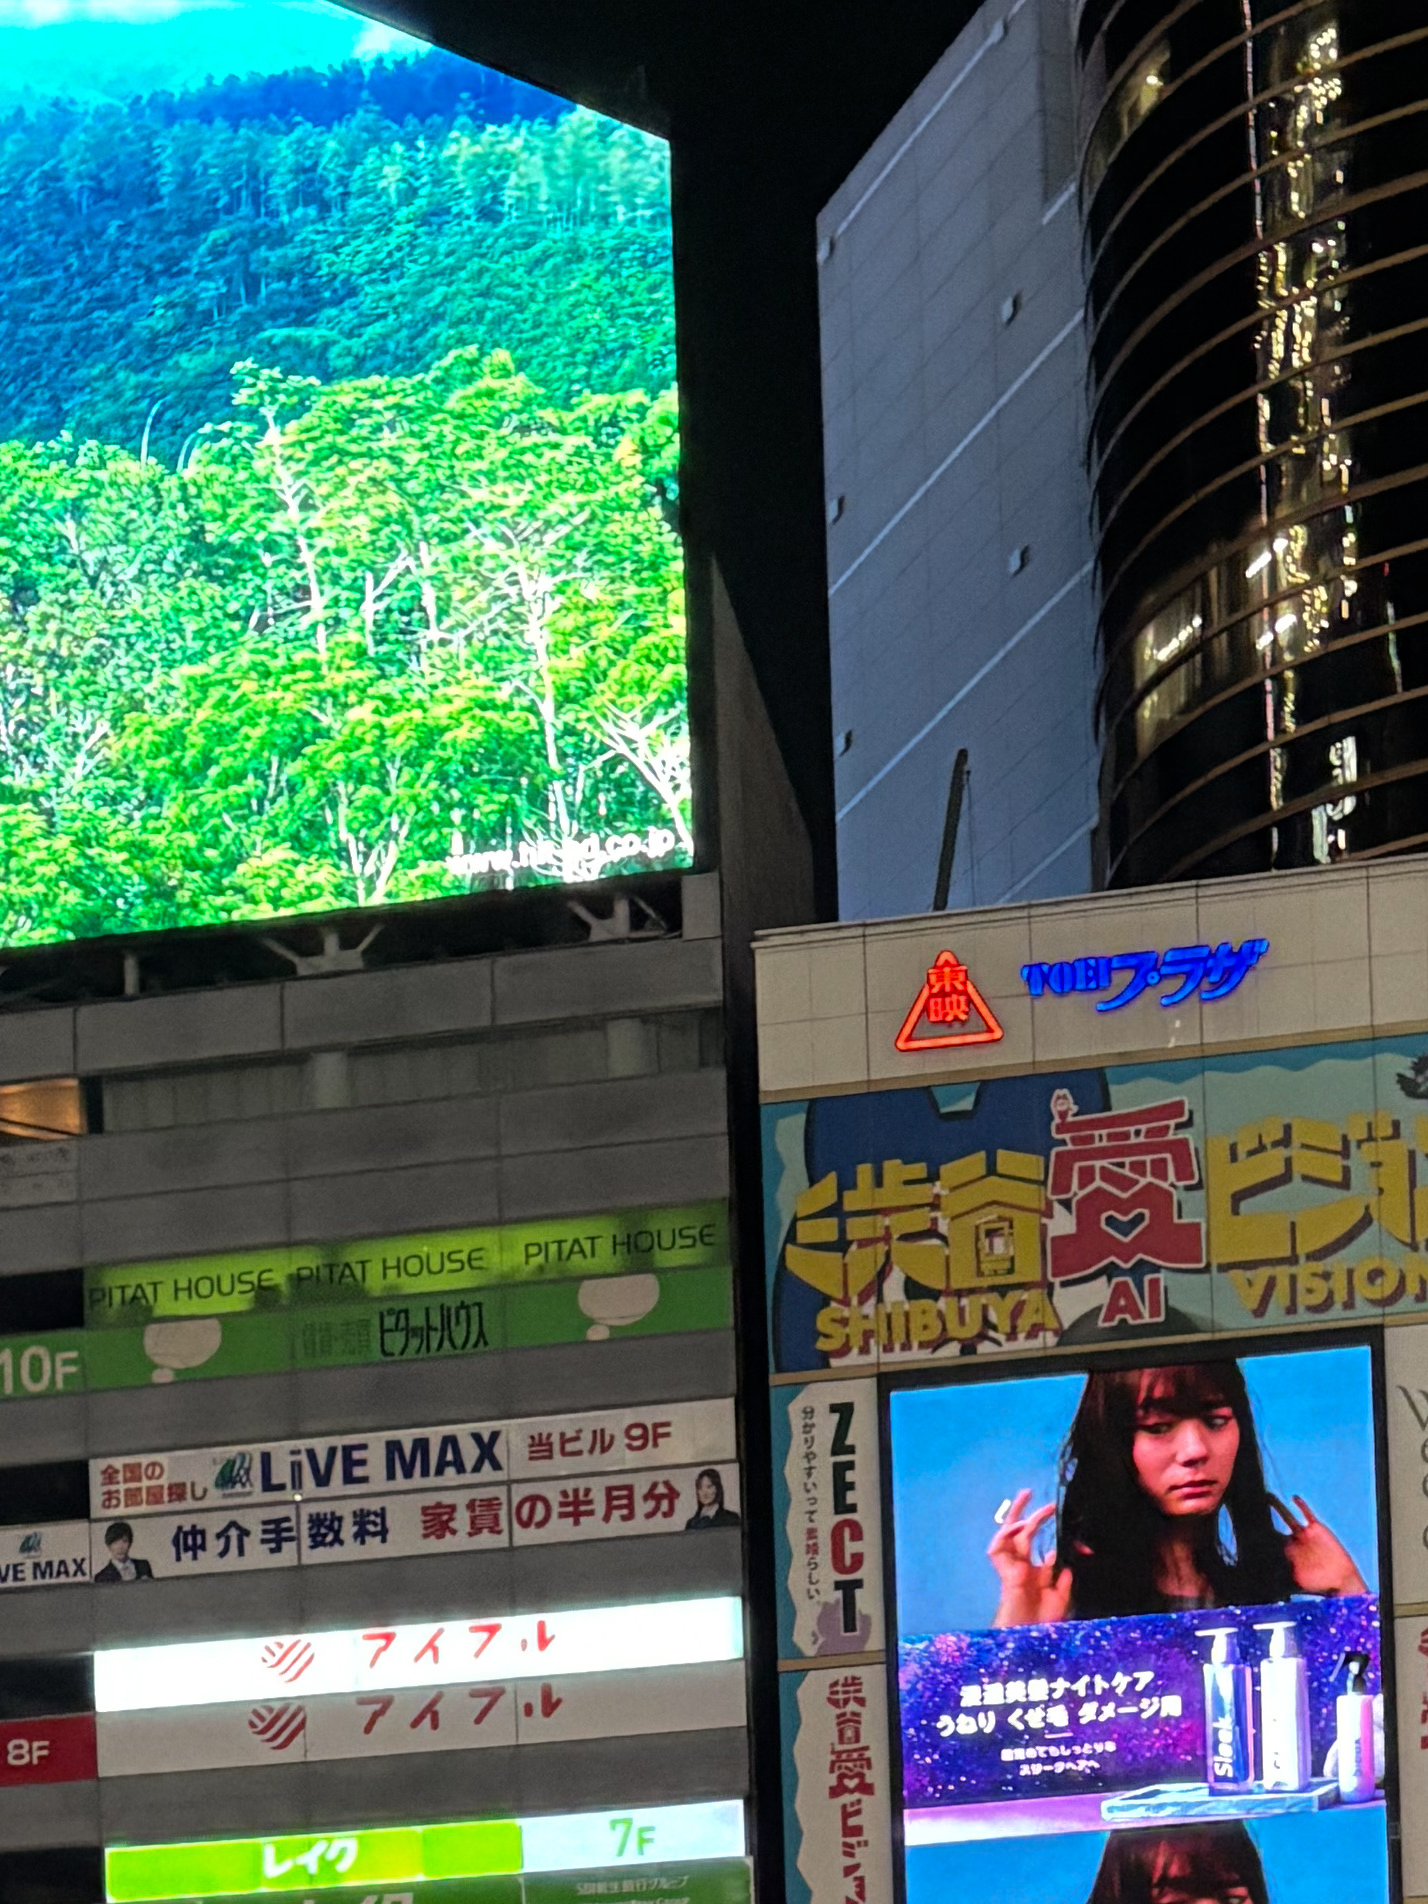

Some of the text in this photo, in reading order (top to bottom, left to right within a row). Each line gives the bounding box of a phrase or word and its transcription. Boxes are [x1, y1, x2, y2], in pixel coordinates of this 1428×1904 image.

[927, 965, 970, 1023] 東映
[1020, 938, 1271, 1012] TOEIプラザ
[89, 1222, 717, 1310] PITAT HOUSE PITAT HOUSE PITAT HOUSE
[814, 1287, 1063, 1356] SHIBUYA
[1098, 1276, 1166, 1326] AI
[378, 1300, 489, 1358] ピタットハウス
[260, 1430, 503, 1493] LiVE MAX
[527, 1420, 672, 1462] 当ビル 9F
[100, 1461, 165, 1487] 全国の
[100, 1481, 209, 1510] お部屋探し
[172, 1479, 681, 1563] 仲介手数料 家賃の半月分
[828, 1401, 865, 1635] ZECT
[32, 1556, 89, 1580] MAX
[361, 1619, 556, 1669] アイフル
[355, 1682, 564, 1736] アイフル
[6, 1738, 51, 1767] 8F
[262, 1837, 360, 1880] レイク
[608, 1817, 656, 1858] 7F
